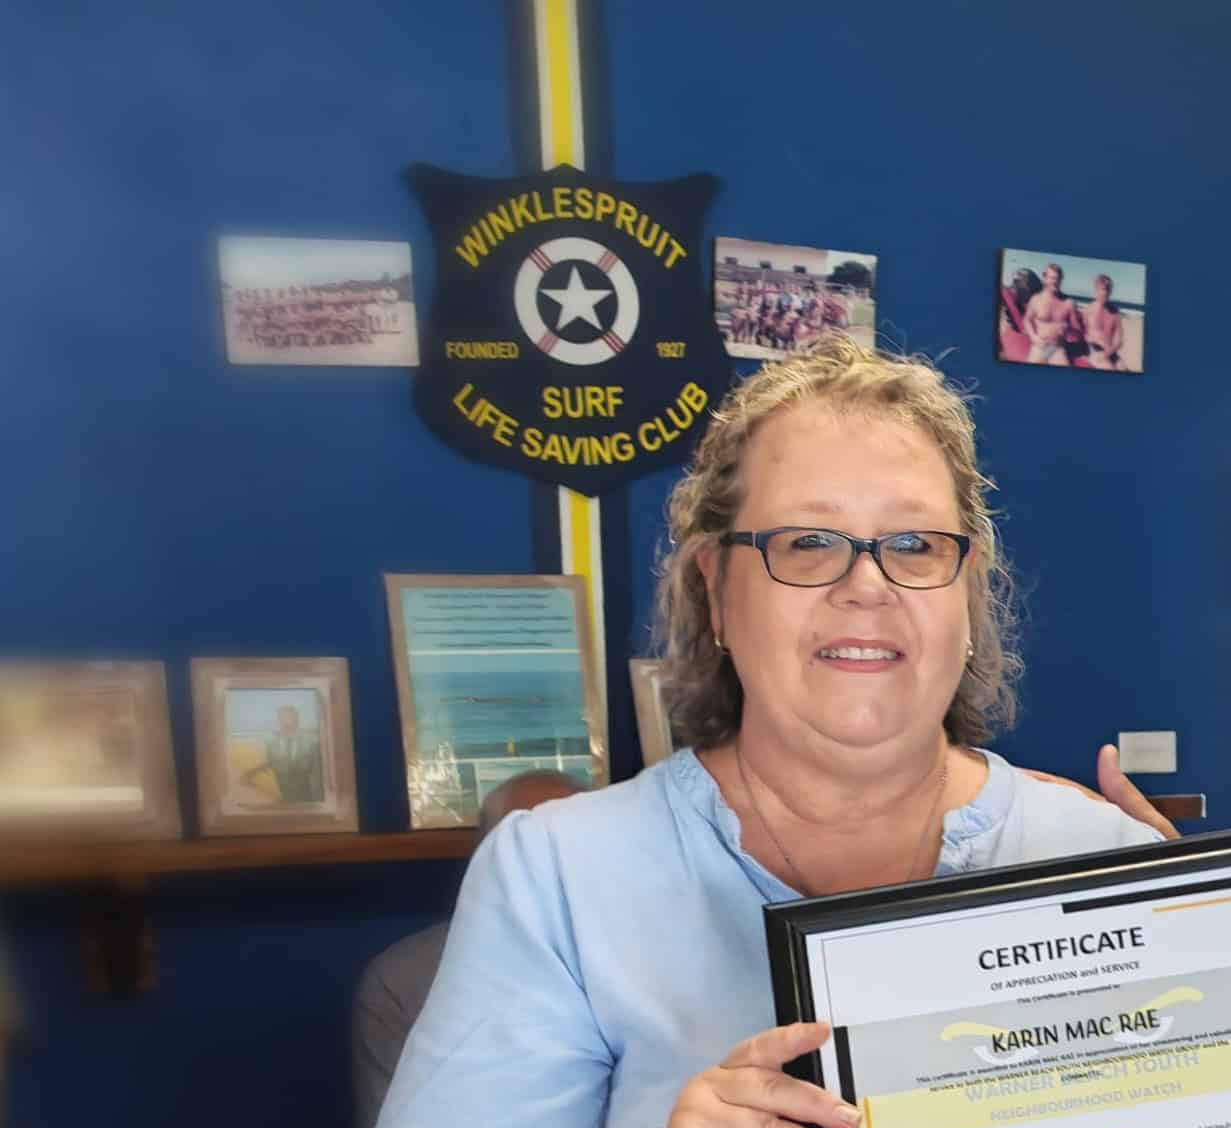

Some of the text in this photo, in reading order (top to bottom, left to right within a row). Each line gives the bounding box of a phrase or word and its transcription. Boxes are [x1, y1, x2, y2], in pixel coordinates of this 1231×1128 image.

[455, 187, 687, 269] WINKLESPRUIT
[446, 342, 519, 359] FOUNDED
[543, 386, 624, 418] SURF
[453, 382, 708, 465] LIFE SAVING CLUB
[978, 926, 1146, 971] CERTIFICATE
[1005, 971, 1078, 989] APPRECIATION
[1100, 961, 1140, 974] SERVICE
[992, 1008, 1161, 1053] KARIN MAC RAE
[964, 1074, 1056, 1103] WARNER
[1127, 1081, 1184, 1101] WATCH
